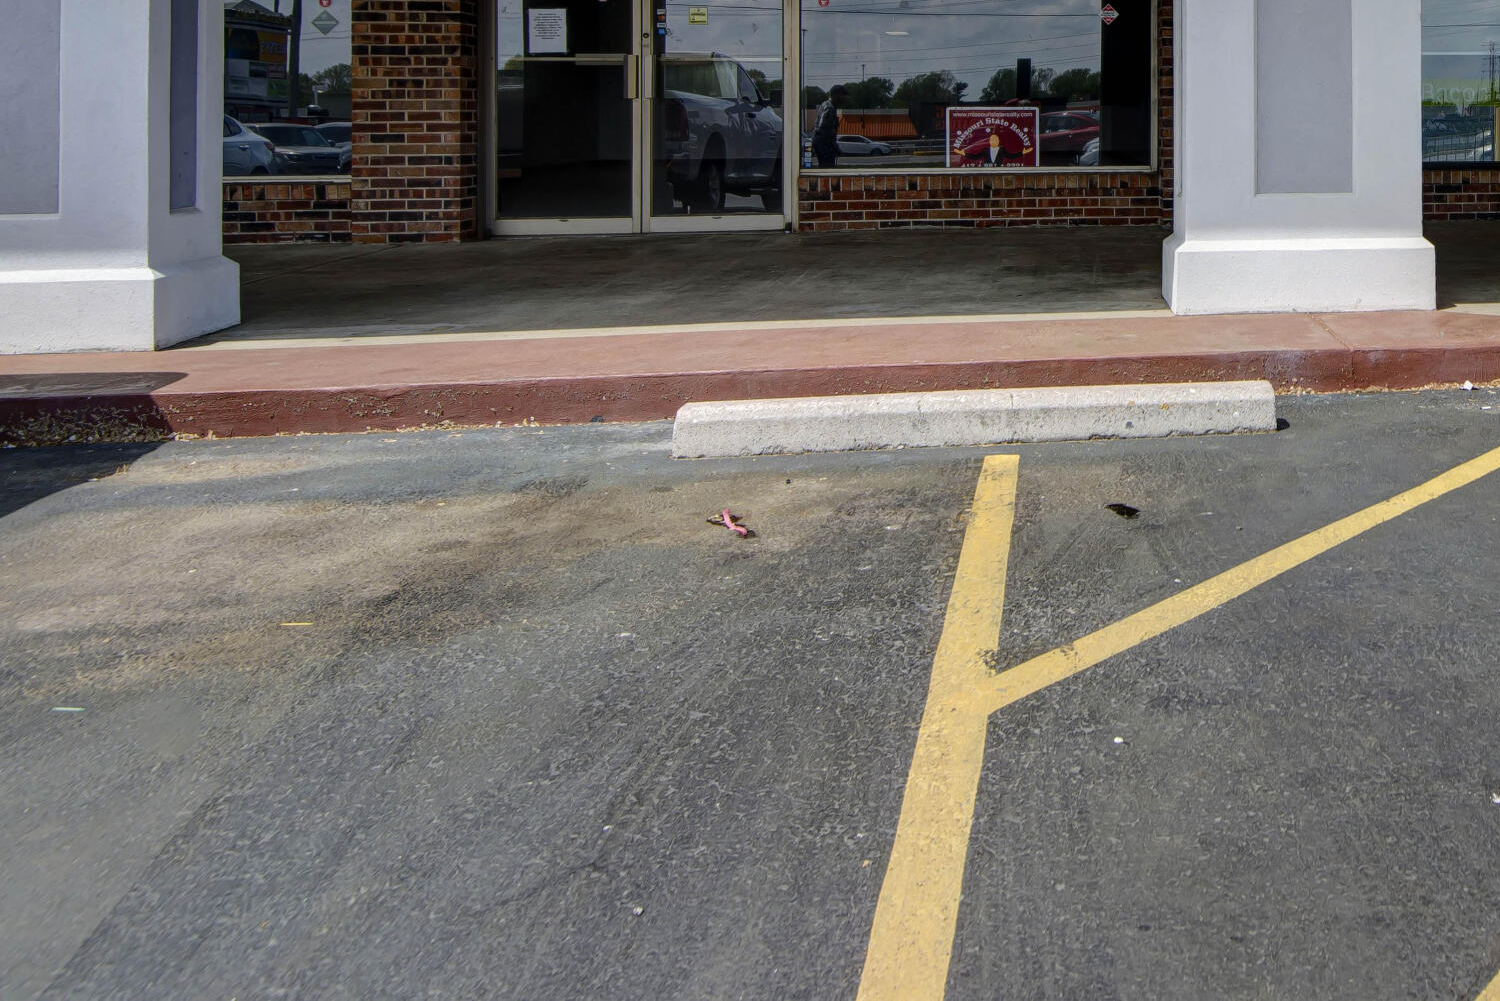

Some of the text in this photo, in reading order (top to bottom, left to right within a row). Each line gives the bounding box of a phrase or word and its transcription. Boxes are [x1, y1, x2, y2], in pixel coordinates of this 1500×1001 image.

[953, 117, 1032, 148] Missouri State Realty
